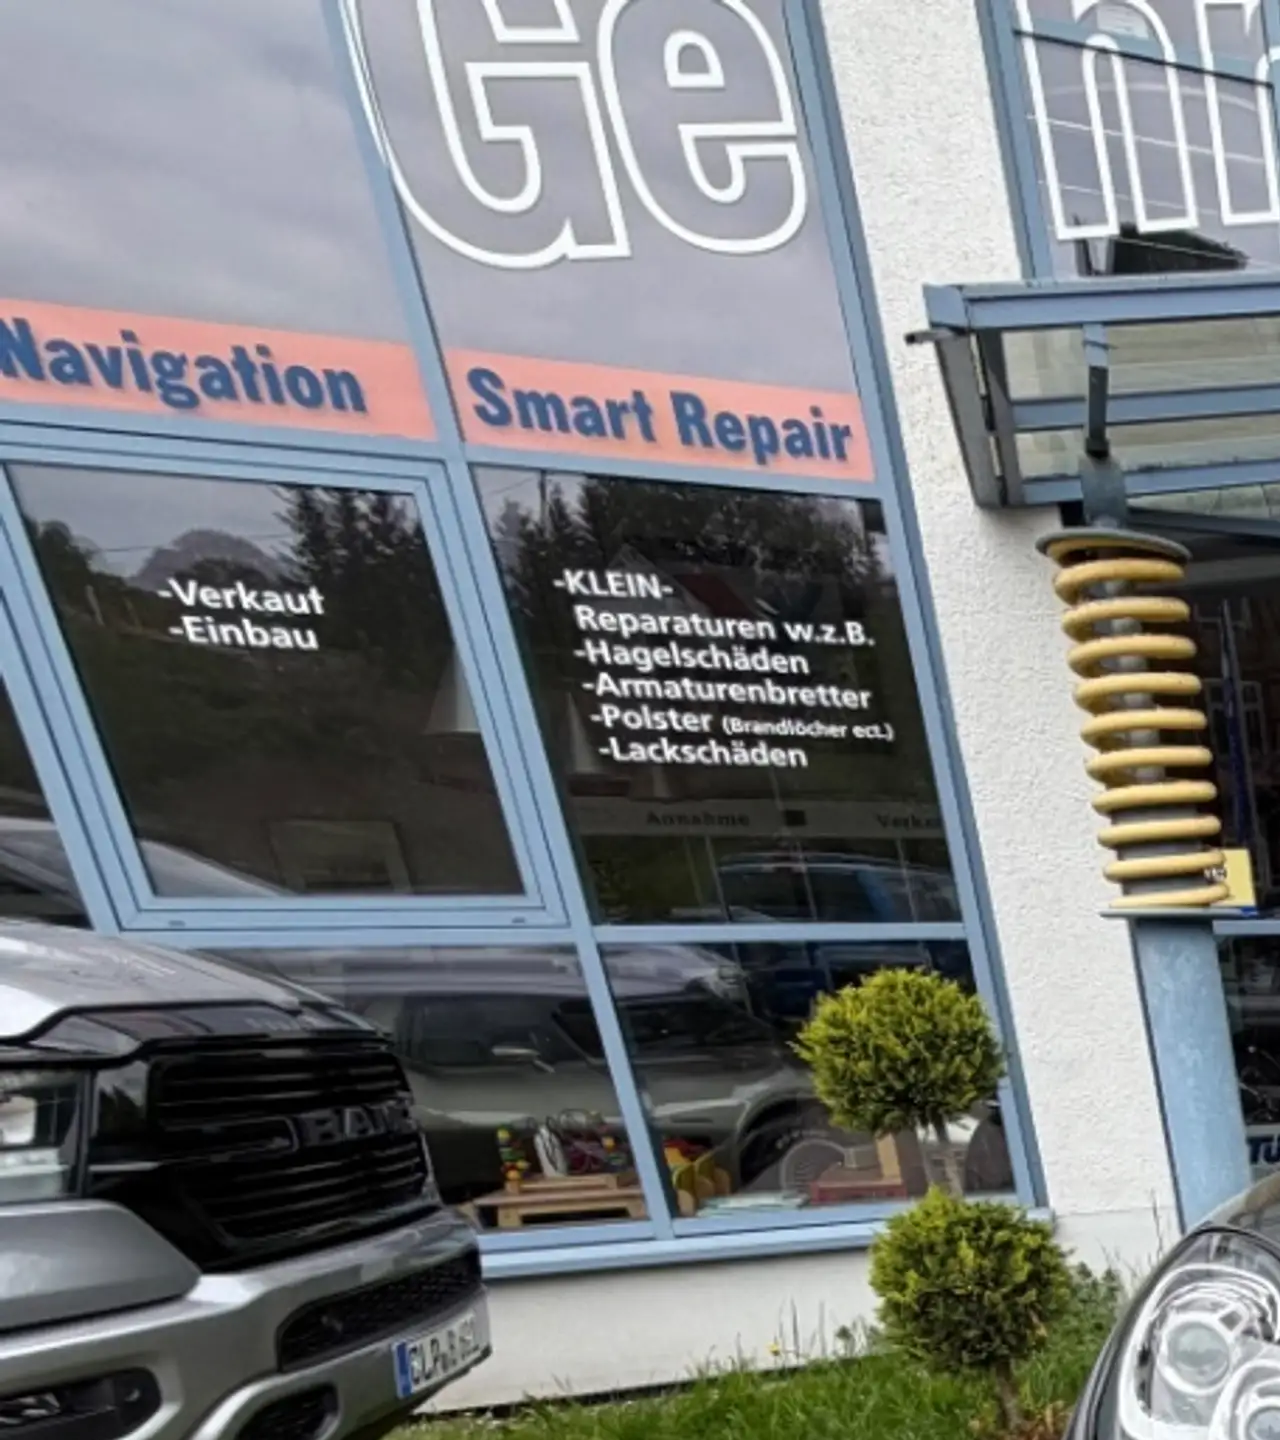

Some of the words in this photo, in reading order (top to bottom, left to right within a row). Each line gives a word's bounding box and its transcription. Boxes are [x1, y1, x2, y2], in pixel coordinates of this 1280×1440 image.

[0, 317, 367, 413] Navigation
[467, 367, 656, 443] Smart
[670, 391, 852, 466] Repair
[553, 569, 673, 599] -KLEIN-
[168, 615, 320, 651] -Einbau
[573, 604, 776, 640] Reparaturen
[784, 621, 875, 646] w.z.B.
[574, 639, 810, 674] -Hagelschäden
[582, 672, 872, 709] -Armaturenbretter
[590, 704, 713, 731] -Polster
[722, 716, 847, 738] (Brandlöcher
[599, 737, 808, 767] -Lackschäden
